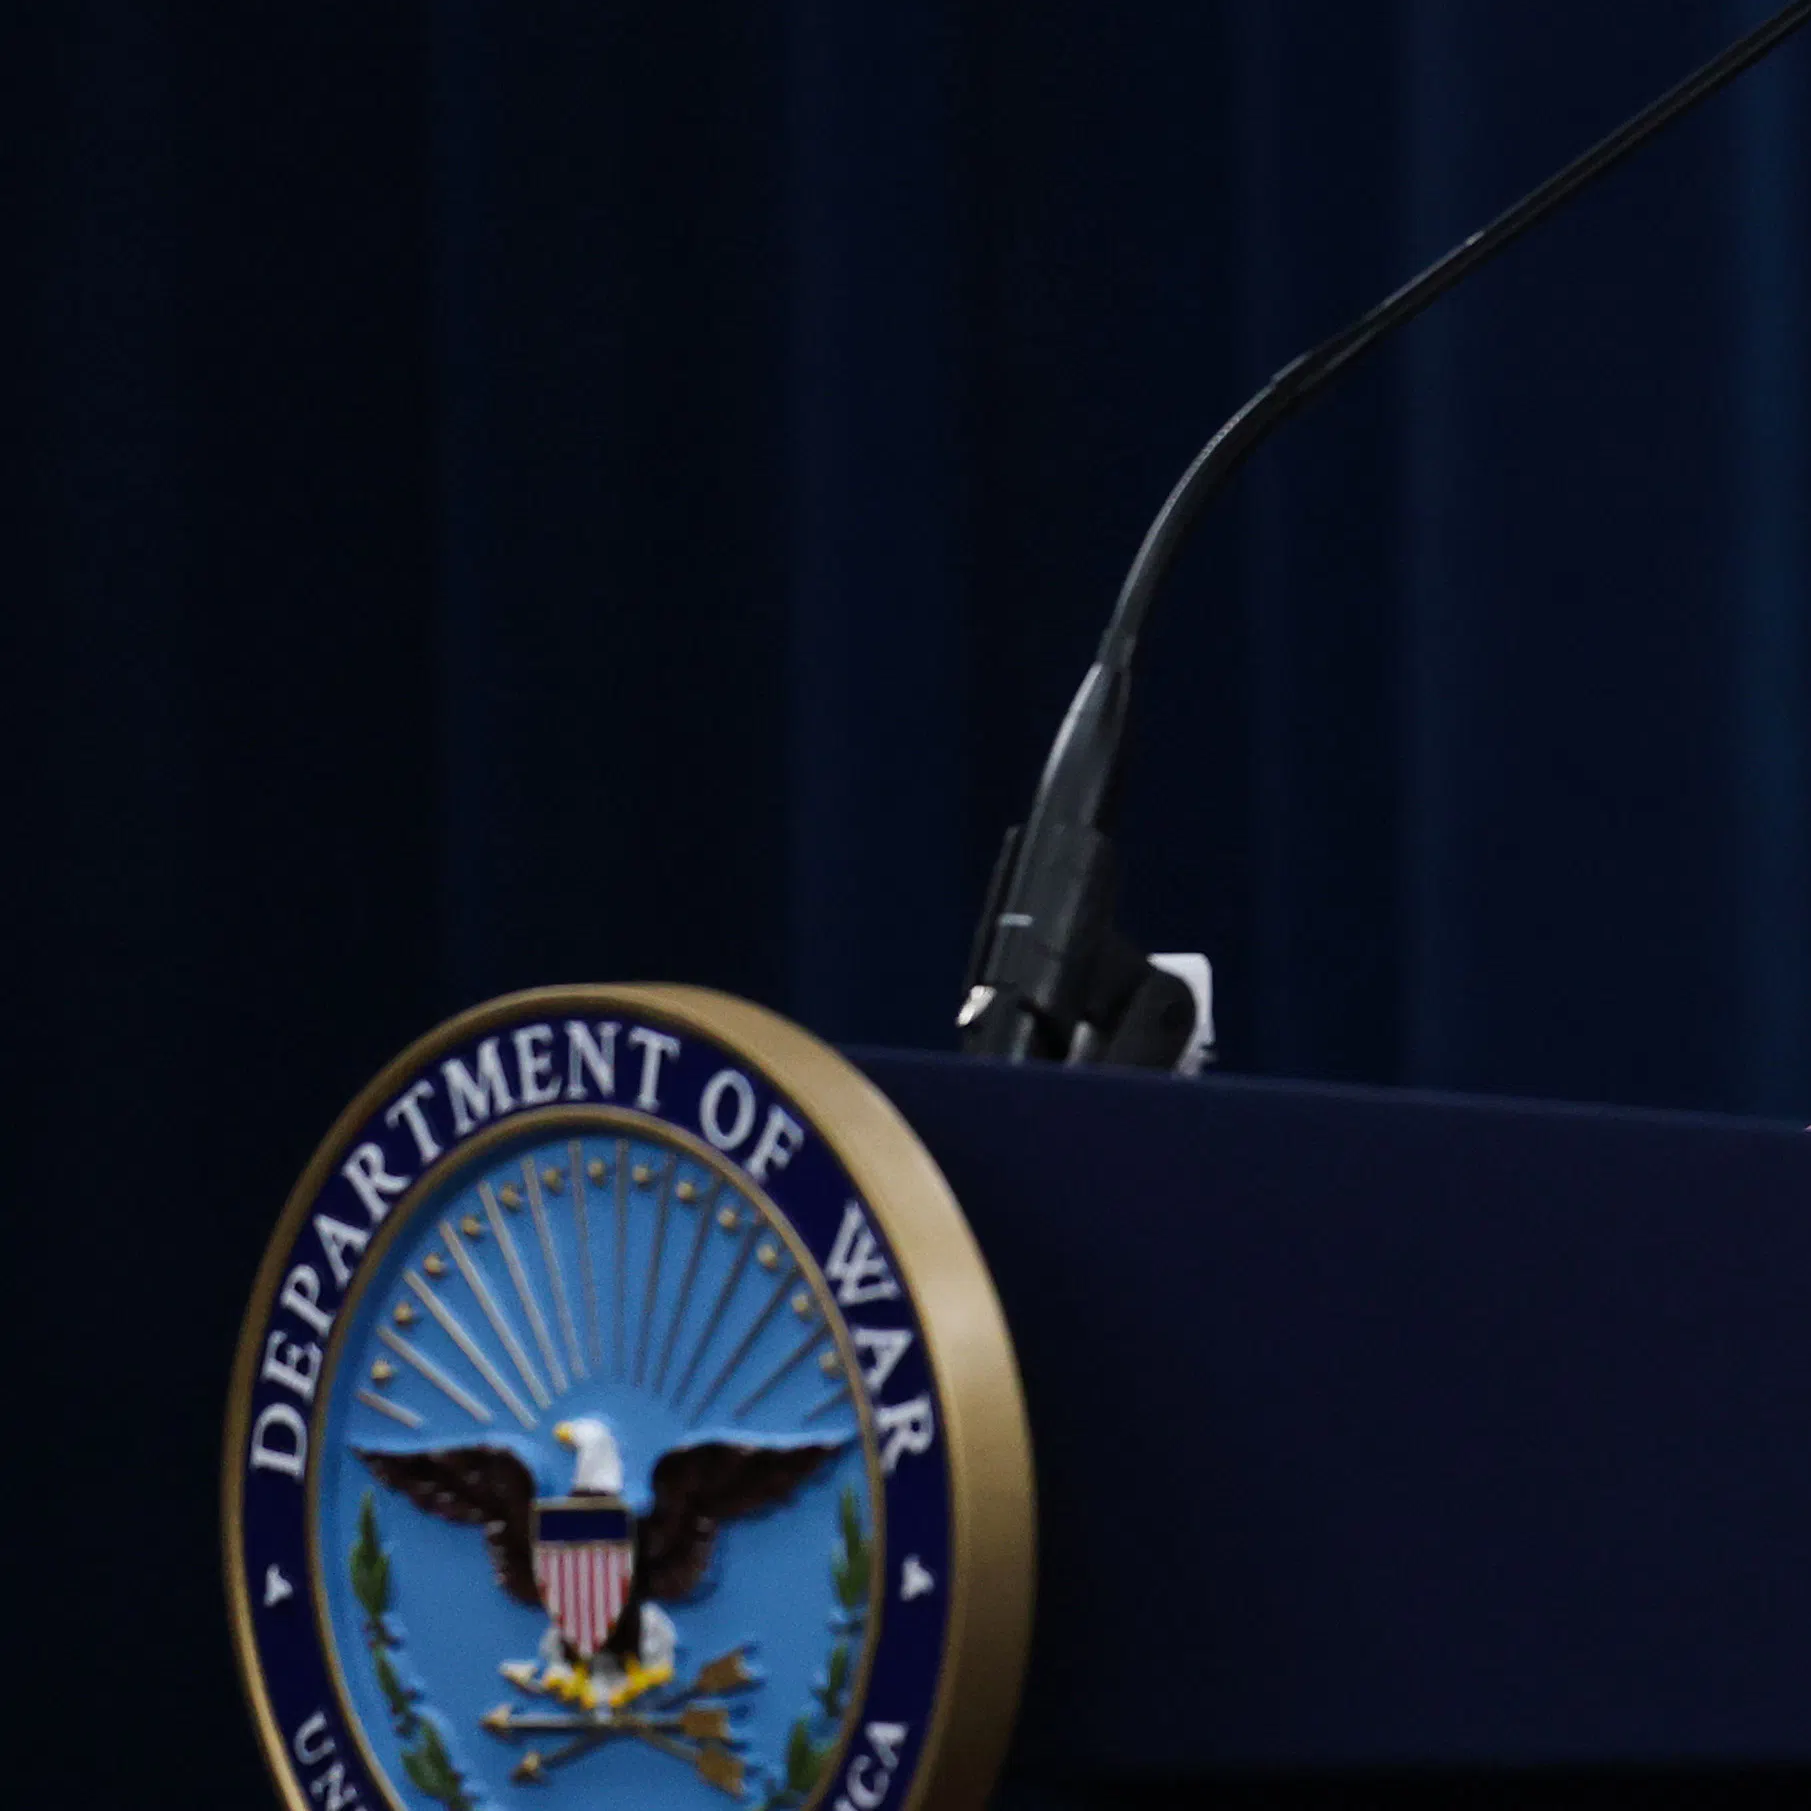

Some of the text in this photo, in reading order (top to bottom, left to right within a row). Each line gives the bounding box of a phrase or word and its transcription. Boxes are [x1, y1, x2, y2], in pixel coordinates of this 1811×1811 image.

[250, 1019, 935, 1479] DEPARTMENT OF WAR
[294, 1710, 908, 1811] UN CA
